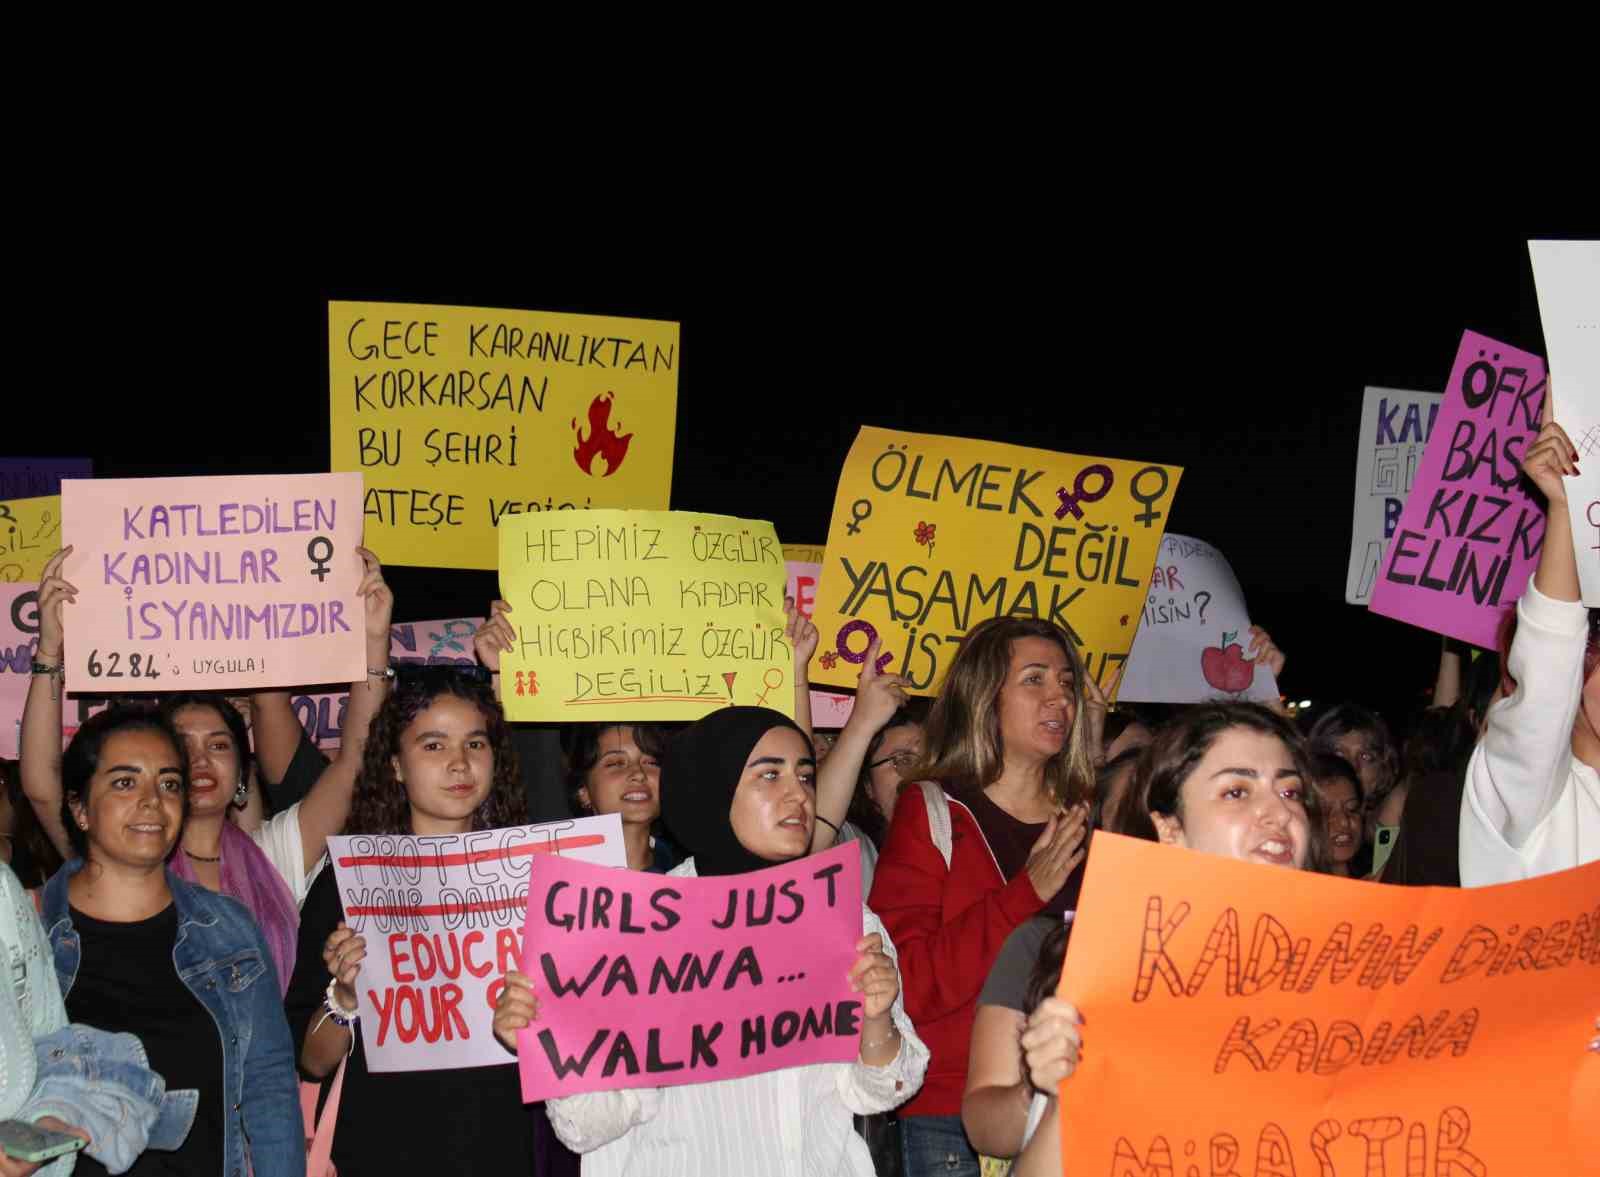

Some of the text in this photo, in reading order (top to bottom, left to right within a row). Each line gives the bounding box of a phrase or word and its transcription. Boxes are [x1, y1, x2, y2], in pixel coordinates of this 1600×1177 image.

[348, 318, 674, 373] GECE KARANLIKTAN
[354, 369, 548, 413] KORKARSAN
[358, 426, 518, 467] BU ŞEHRİ
[1441, 420, 1526, 493] BAŞ
[871, 443, 1046, 518] ÖLMEK
[124, 498, 336, 540] KATLEDİLEN
[363, 487, 464, 531] ATEŞE
[104, 549, 281, 585] KADINLAR
[525, 523, 779, 565] HEPİMİZ ÖZGÜR
[1013, 521, 1140, 588] DEĞİL
[126, 587, 351, 640] İSYANIMIZDIR
[530, 576, 774, 612] OLANA KADAR
[838, 556, 1086, 647] YAŞAMAK
[519, 622, 791, 661] HİÇBİRİMİZ ÖZGÜR
[349, 820, 576, 887] PROTECT
[346, 887, 430, 934] YOUR
[544, 863, 844, 934] GIRLS JUST
[388, 927, 524, 984] EDUCA
[1132, 895, 1443, 1003] KADININ
[367, 983, 471, 1047] YOUR
[537, 1000, 862, 1080] WALK HOME
[1214, 1007, 1480, 1076] KADINA
